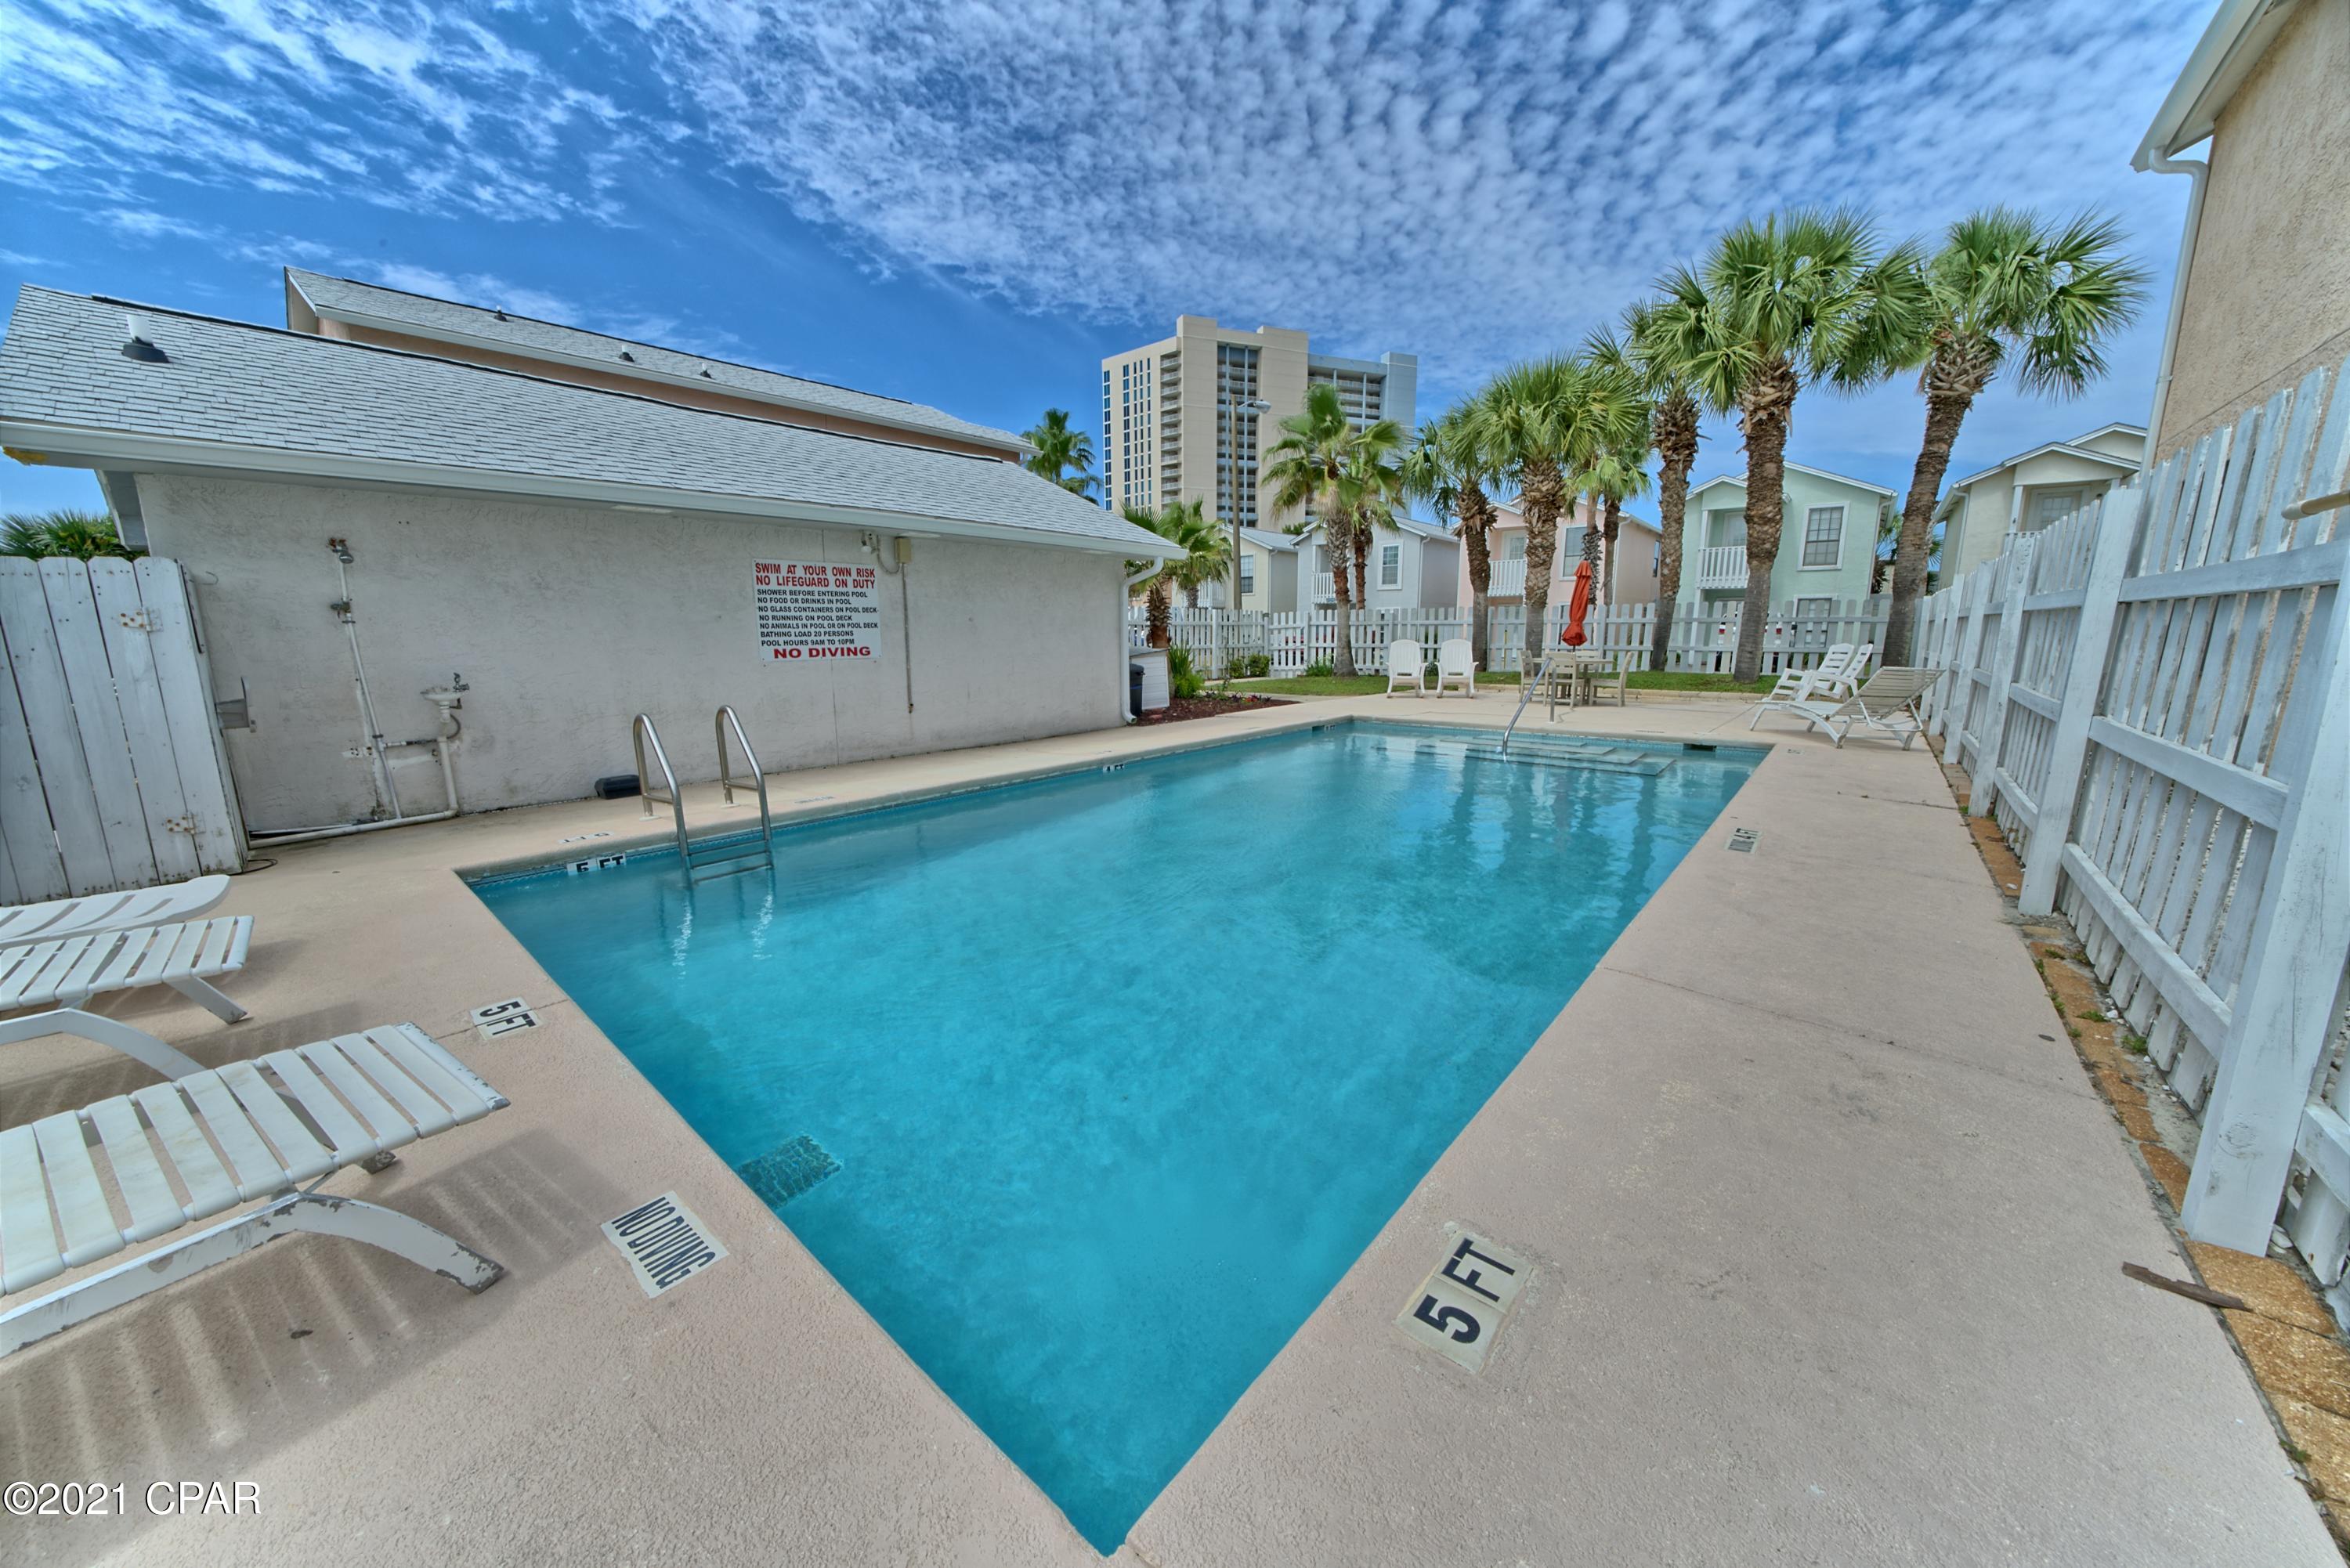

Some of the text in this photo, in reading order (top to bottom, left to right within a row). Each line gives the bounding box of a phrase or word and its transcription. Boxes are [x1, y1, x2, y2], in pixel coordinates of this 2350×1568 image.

[755, 562, 875, 578] SWIM AT YOUR OWN RISK
[756, 575, 875, 589] NO LIFEGUARD ON DUTY
[774, 646, 871, 659] NO DIVING
[599, 854, 624, 869] FT
[479, 1001, 536, 1035] 5 FT
[1413, 1237, 1516, 1344] 5 FT
